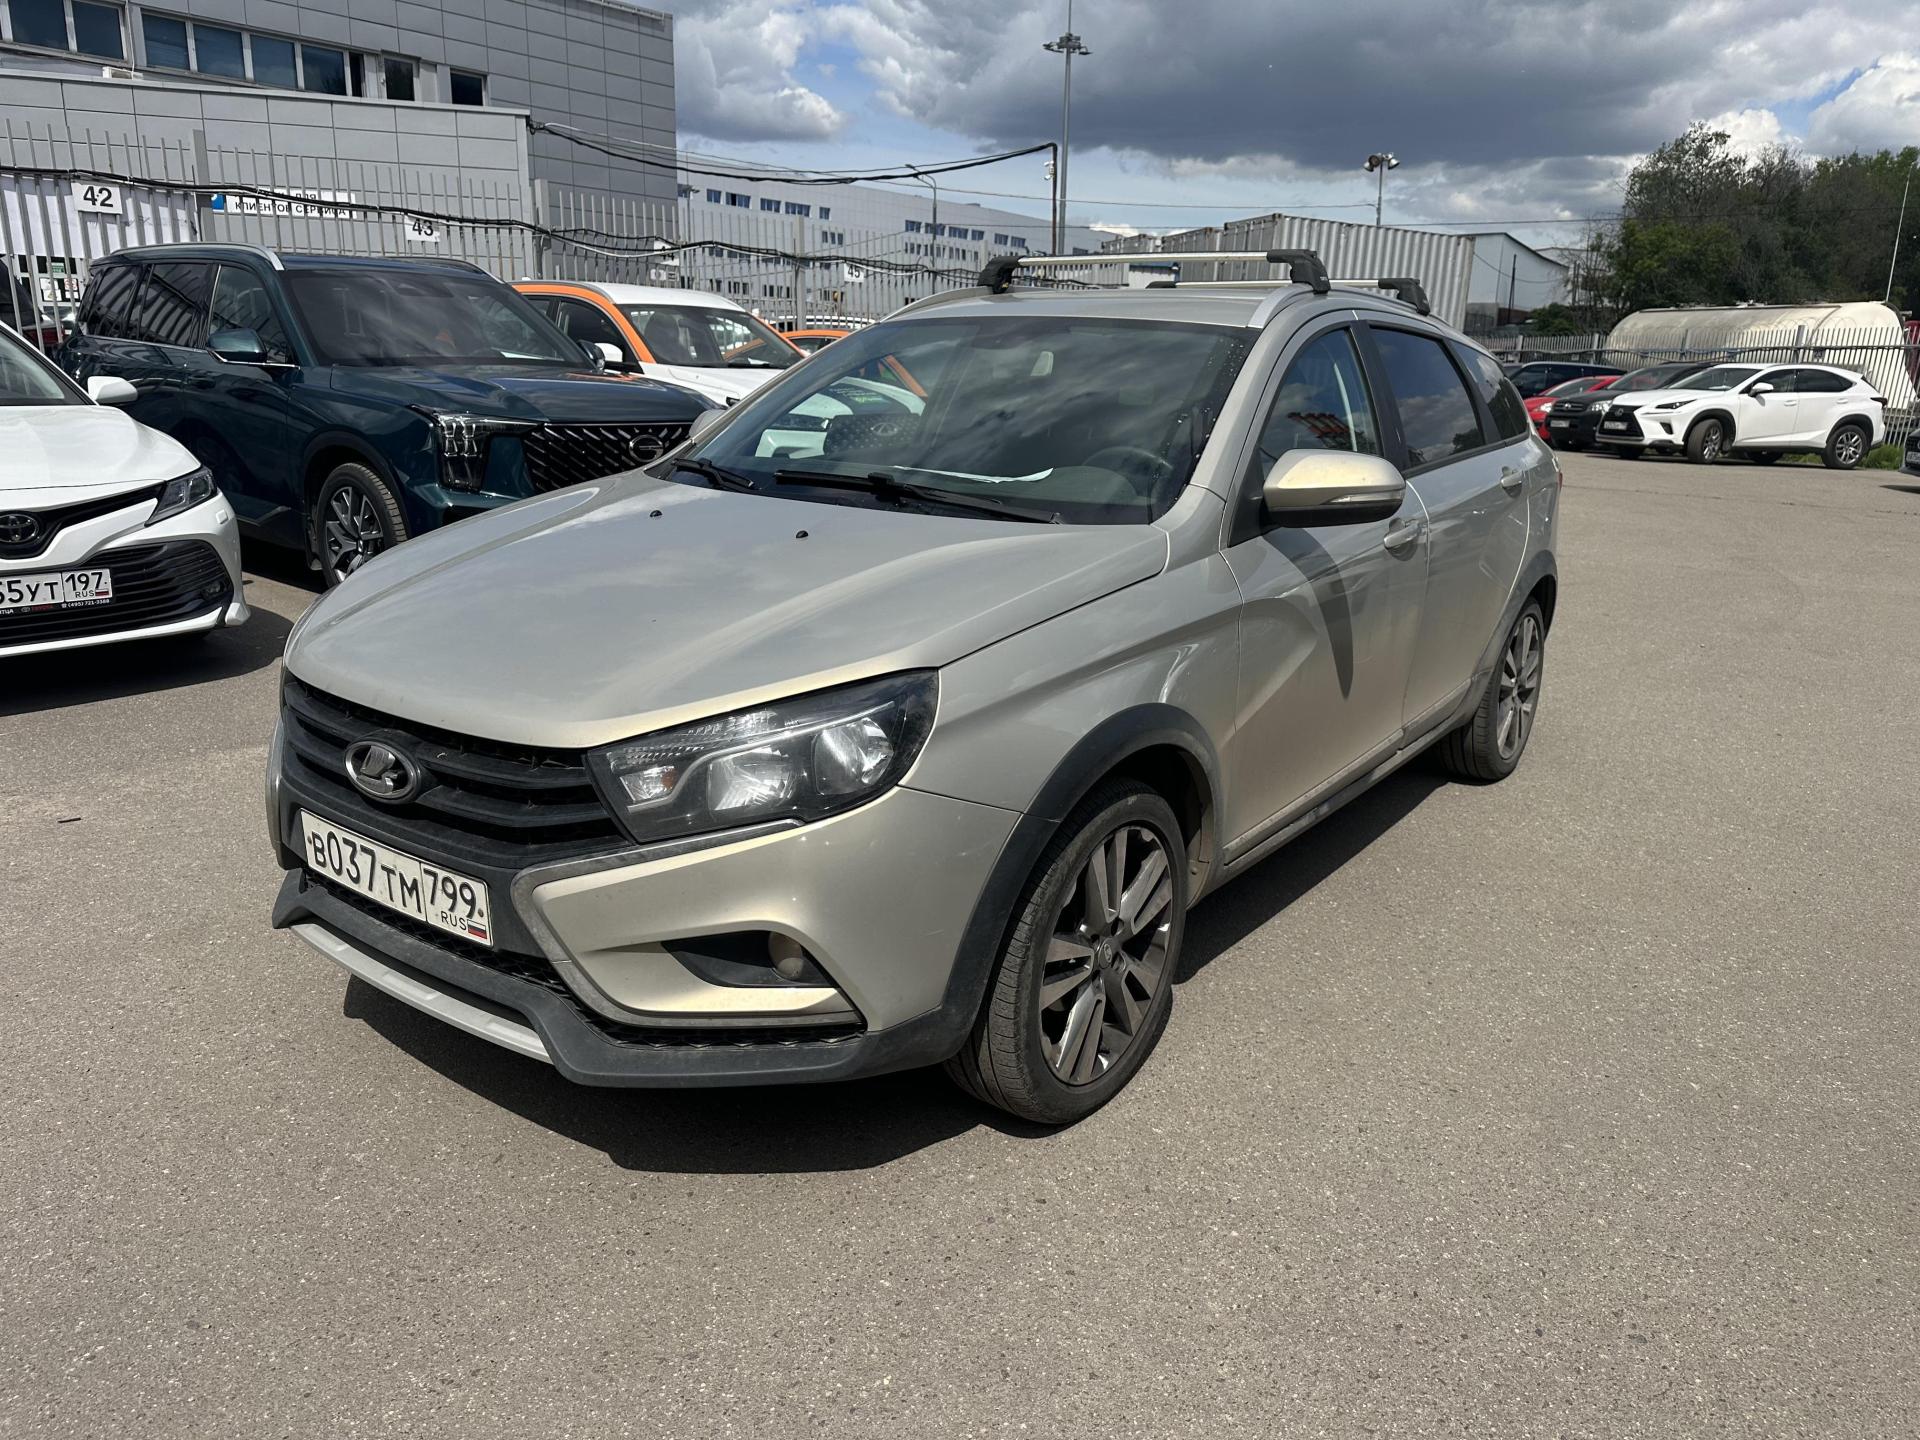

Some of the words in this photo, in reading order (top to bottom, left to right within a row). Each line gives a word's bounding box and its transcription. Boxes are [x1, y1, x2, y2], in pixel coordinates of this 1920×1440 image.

[83, 186, 114, 208] 42
[412, 218, 434, 236] 43
[65, 572, 103, 591] 197
[75, 590, 95, 598] RUS
[423, 867, 477, 920] 799
[441, 910, 467, 931] RUS
